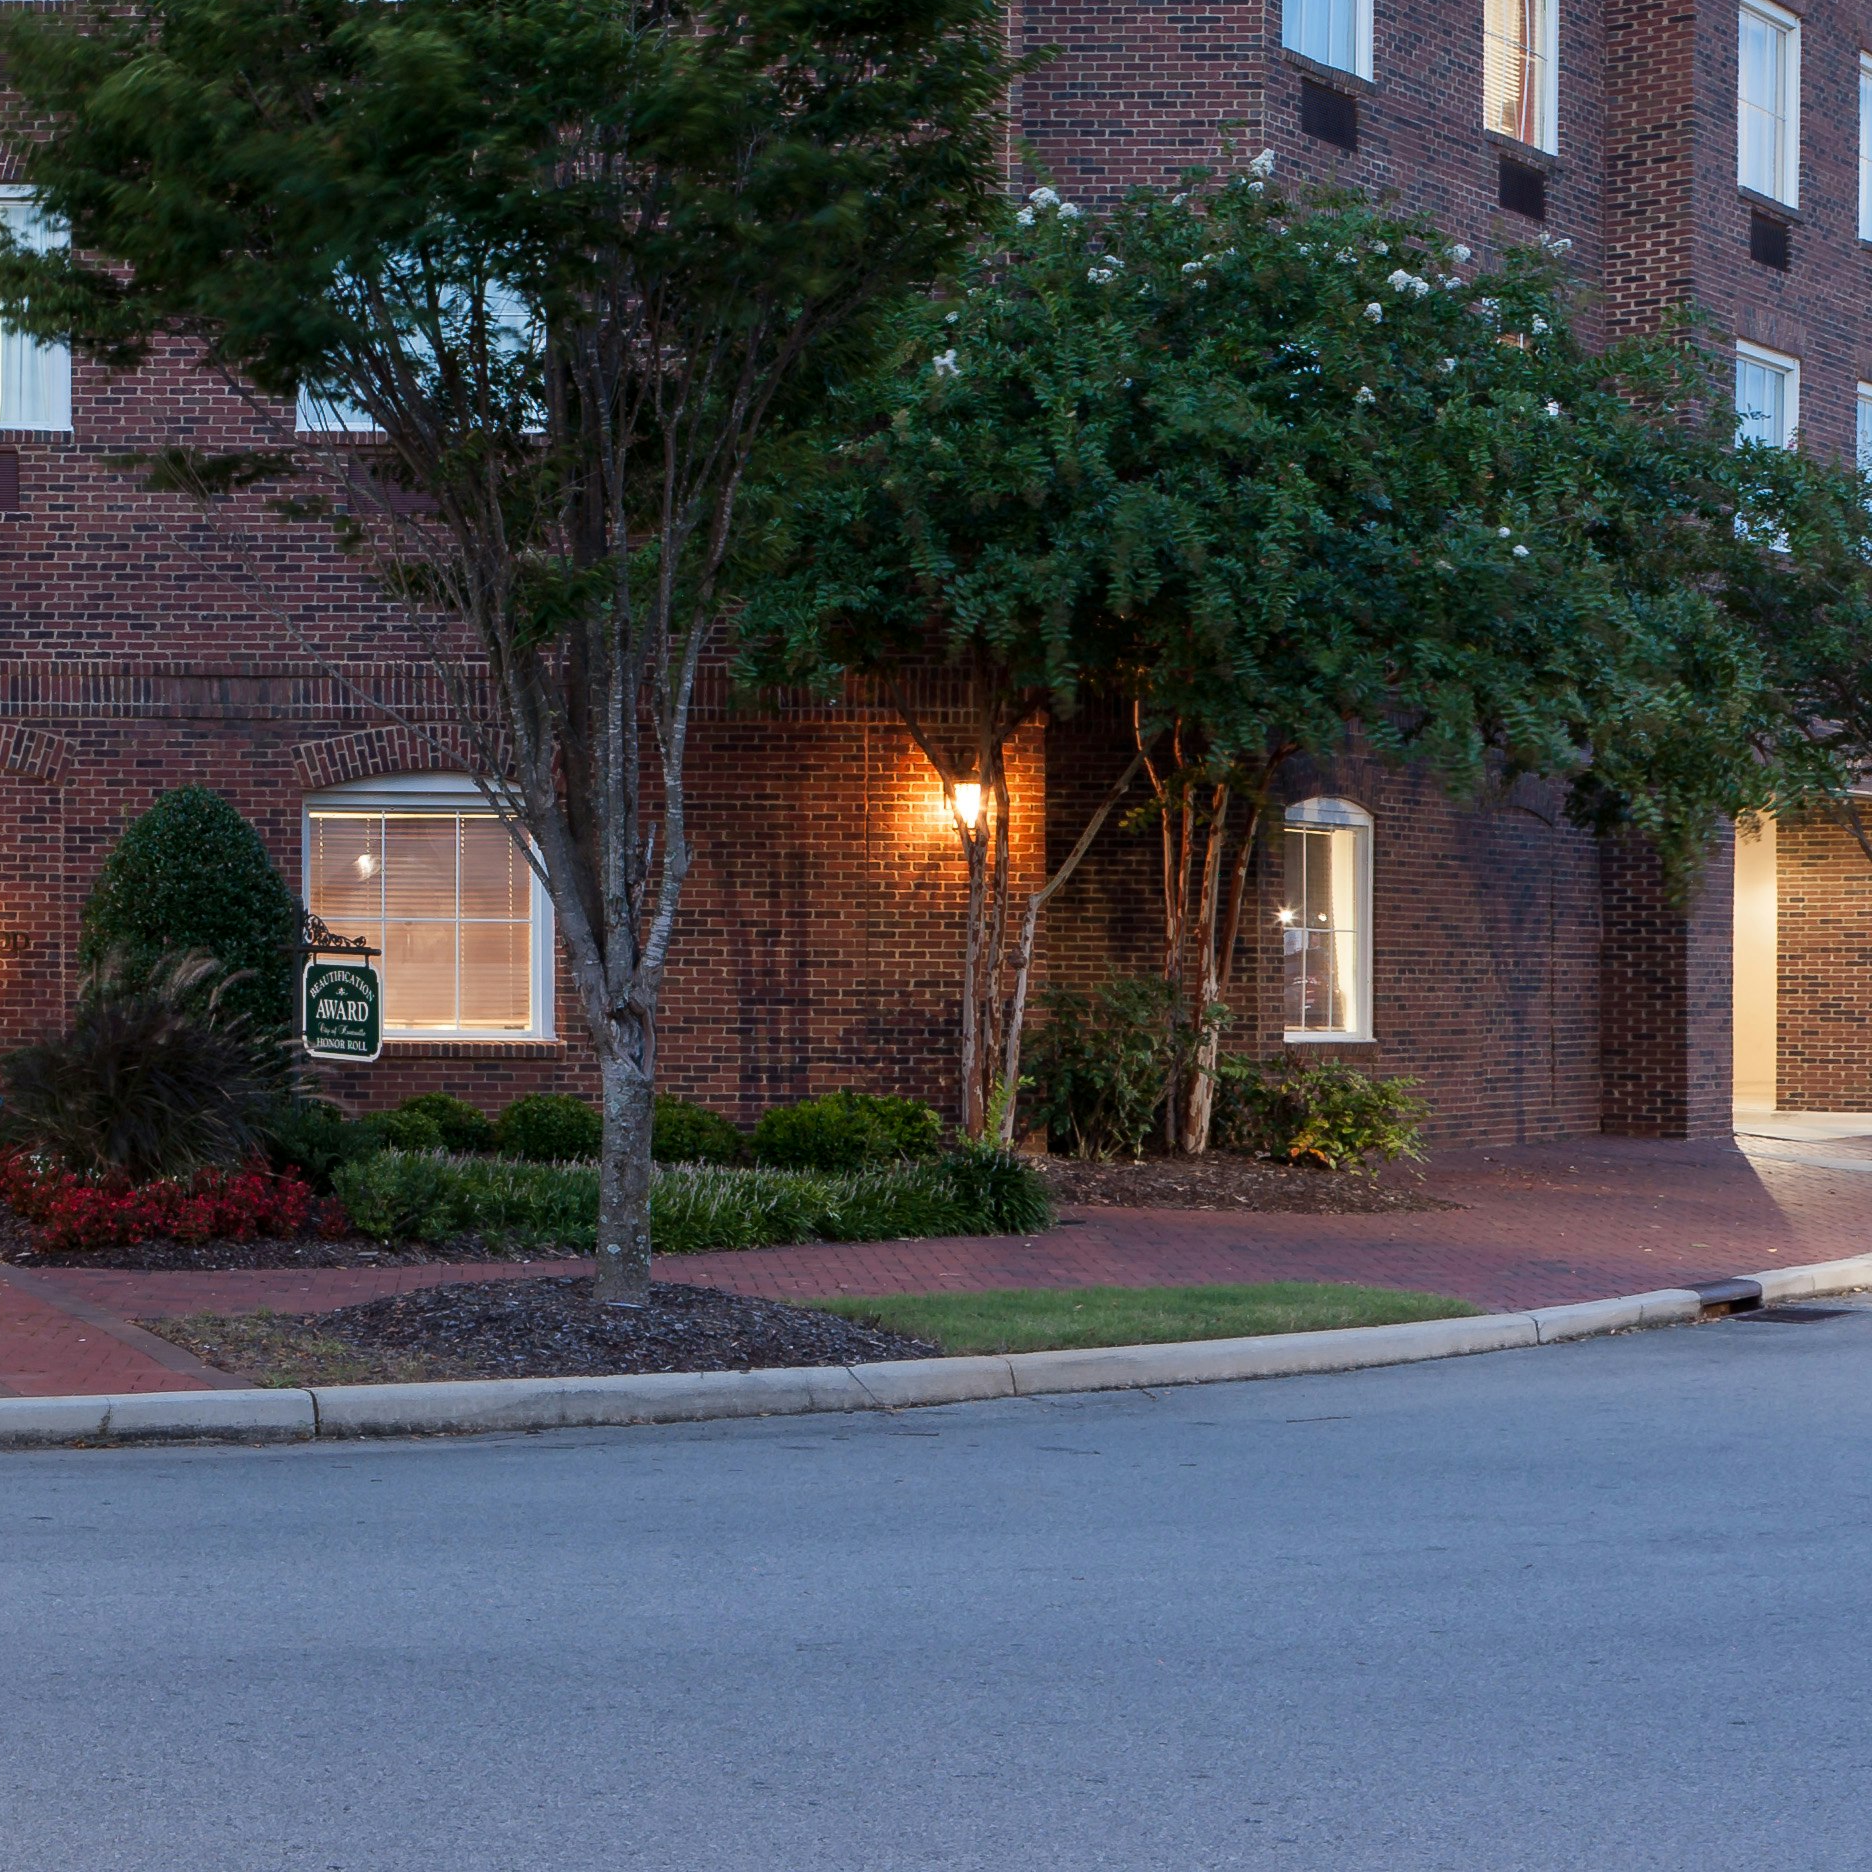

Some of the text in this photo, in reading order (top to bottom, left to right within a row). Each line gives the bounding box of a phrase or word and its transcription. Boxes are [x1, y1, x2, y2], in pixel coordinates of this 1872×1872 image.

[309, 970, 375, 1002] BEAUTIFICATION
[315, 998, 369, 1022] AWARD
[316, 1037, 368, 1052] HONOR ROLL
